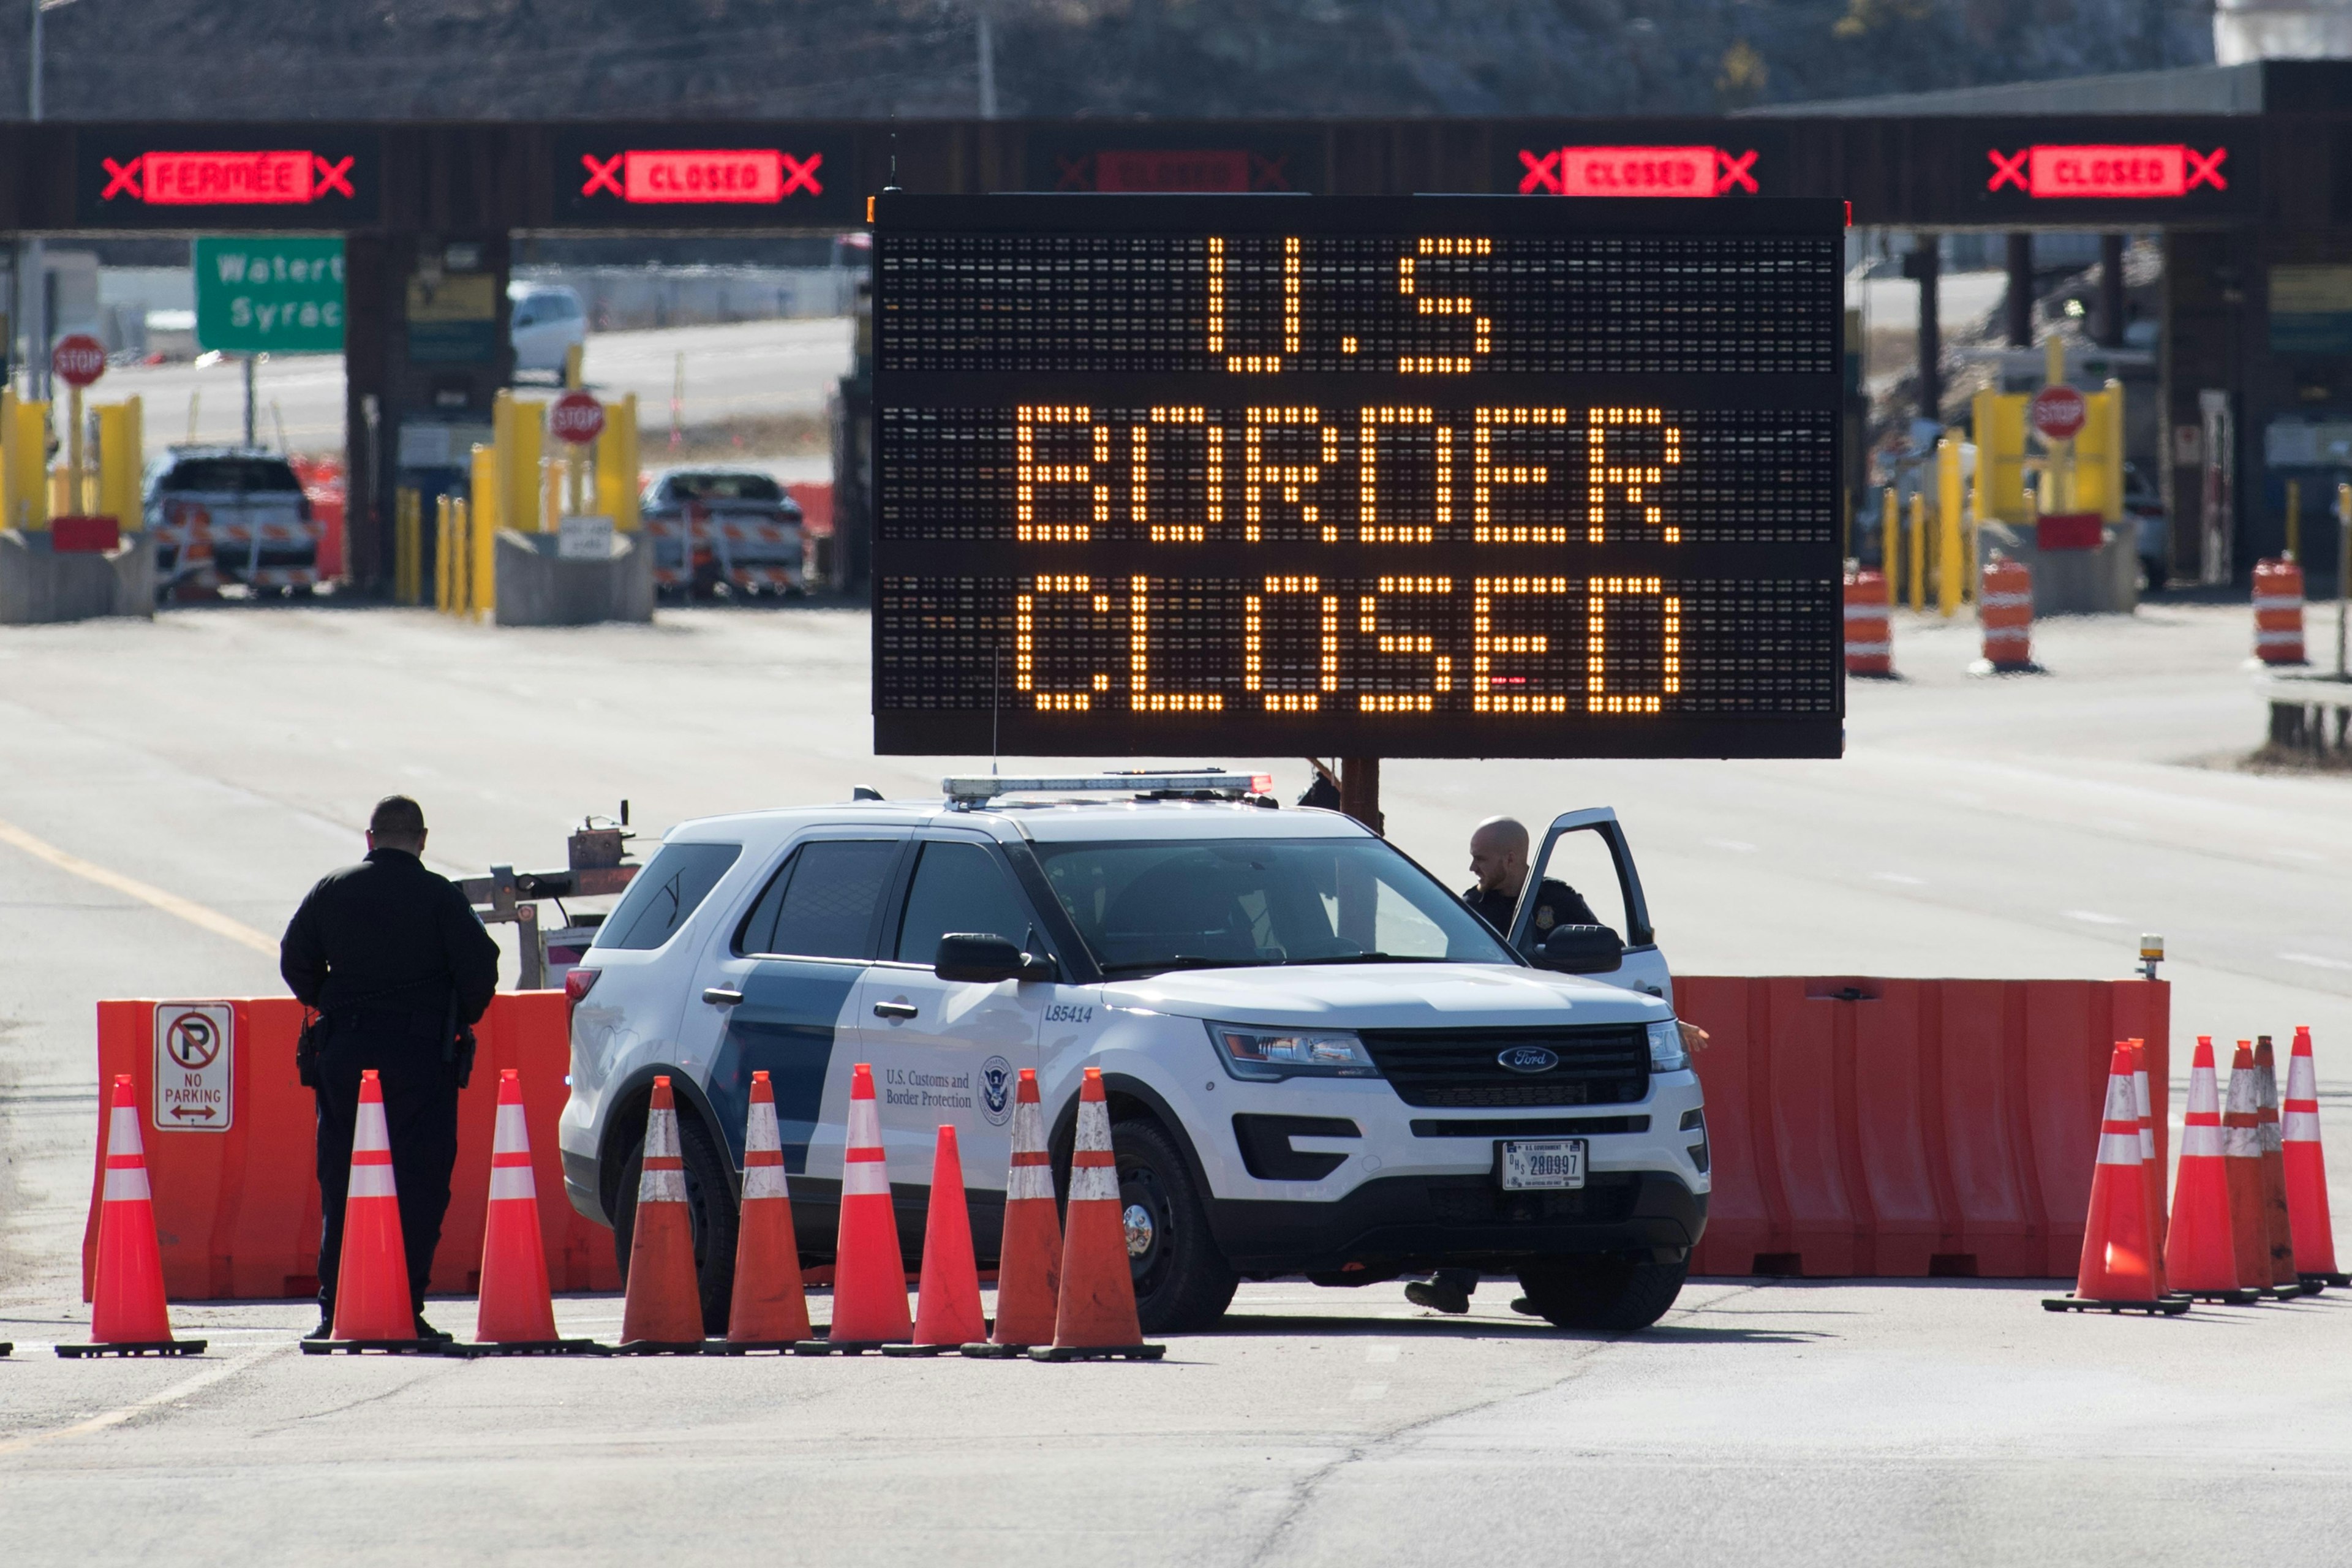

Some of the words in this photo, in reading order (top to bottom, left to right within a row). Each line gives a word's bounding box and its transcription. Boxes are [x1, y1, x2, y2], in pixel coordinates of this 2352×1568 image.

[156, 153, 294, 194] FERMÉE
[649, 164, 759, 191] CLOSED
[1585, 160, 1695, 187] CLOSED
[2054, 159, 2164, 186] CLOSED
[1210, 238, 1490, 372] U.S
[58, 349, 102, 374] STOP
[556, 407, 601, 430] STOP
[2037, 401, 2081, 423] STOP
[1019, 407, 1679, 542] BORDER
[1018, 576, 1679, 712] CLOSED
[1045, 1005, 1093, 1023] L85414
[1515, 1050, 1547, 1065] Ford
[184, 1073, 202, 1087] NO
[886, 1069, 905, 1085] U.S.
[908, 1070, 949, 1088] Customs
[951, 1072, 969, 1089] and
[165, 1089, 221, 1103] PARKING
[886, 1089, 919, 1106] Border
[922, 1091, 972, 1109] Protection
[1531, 1155, 1577, 1175] 280997
